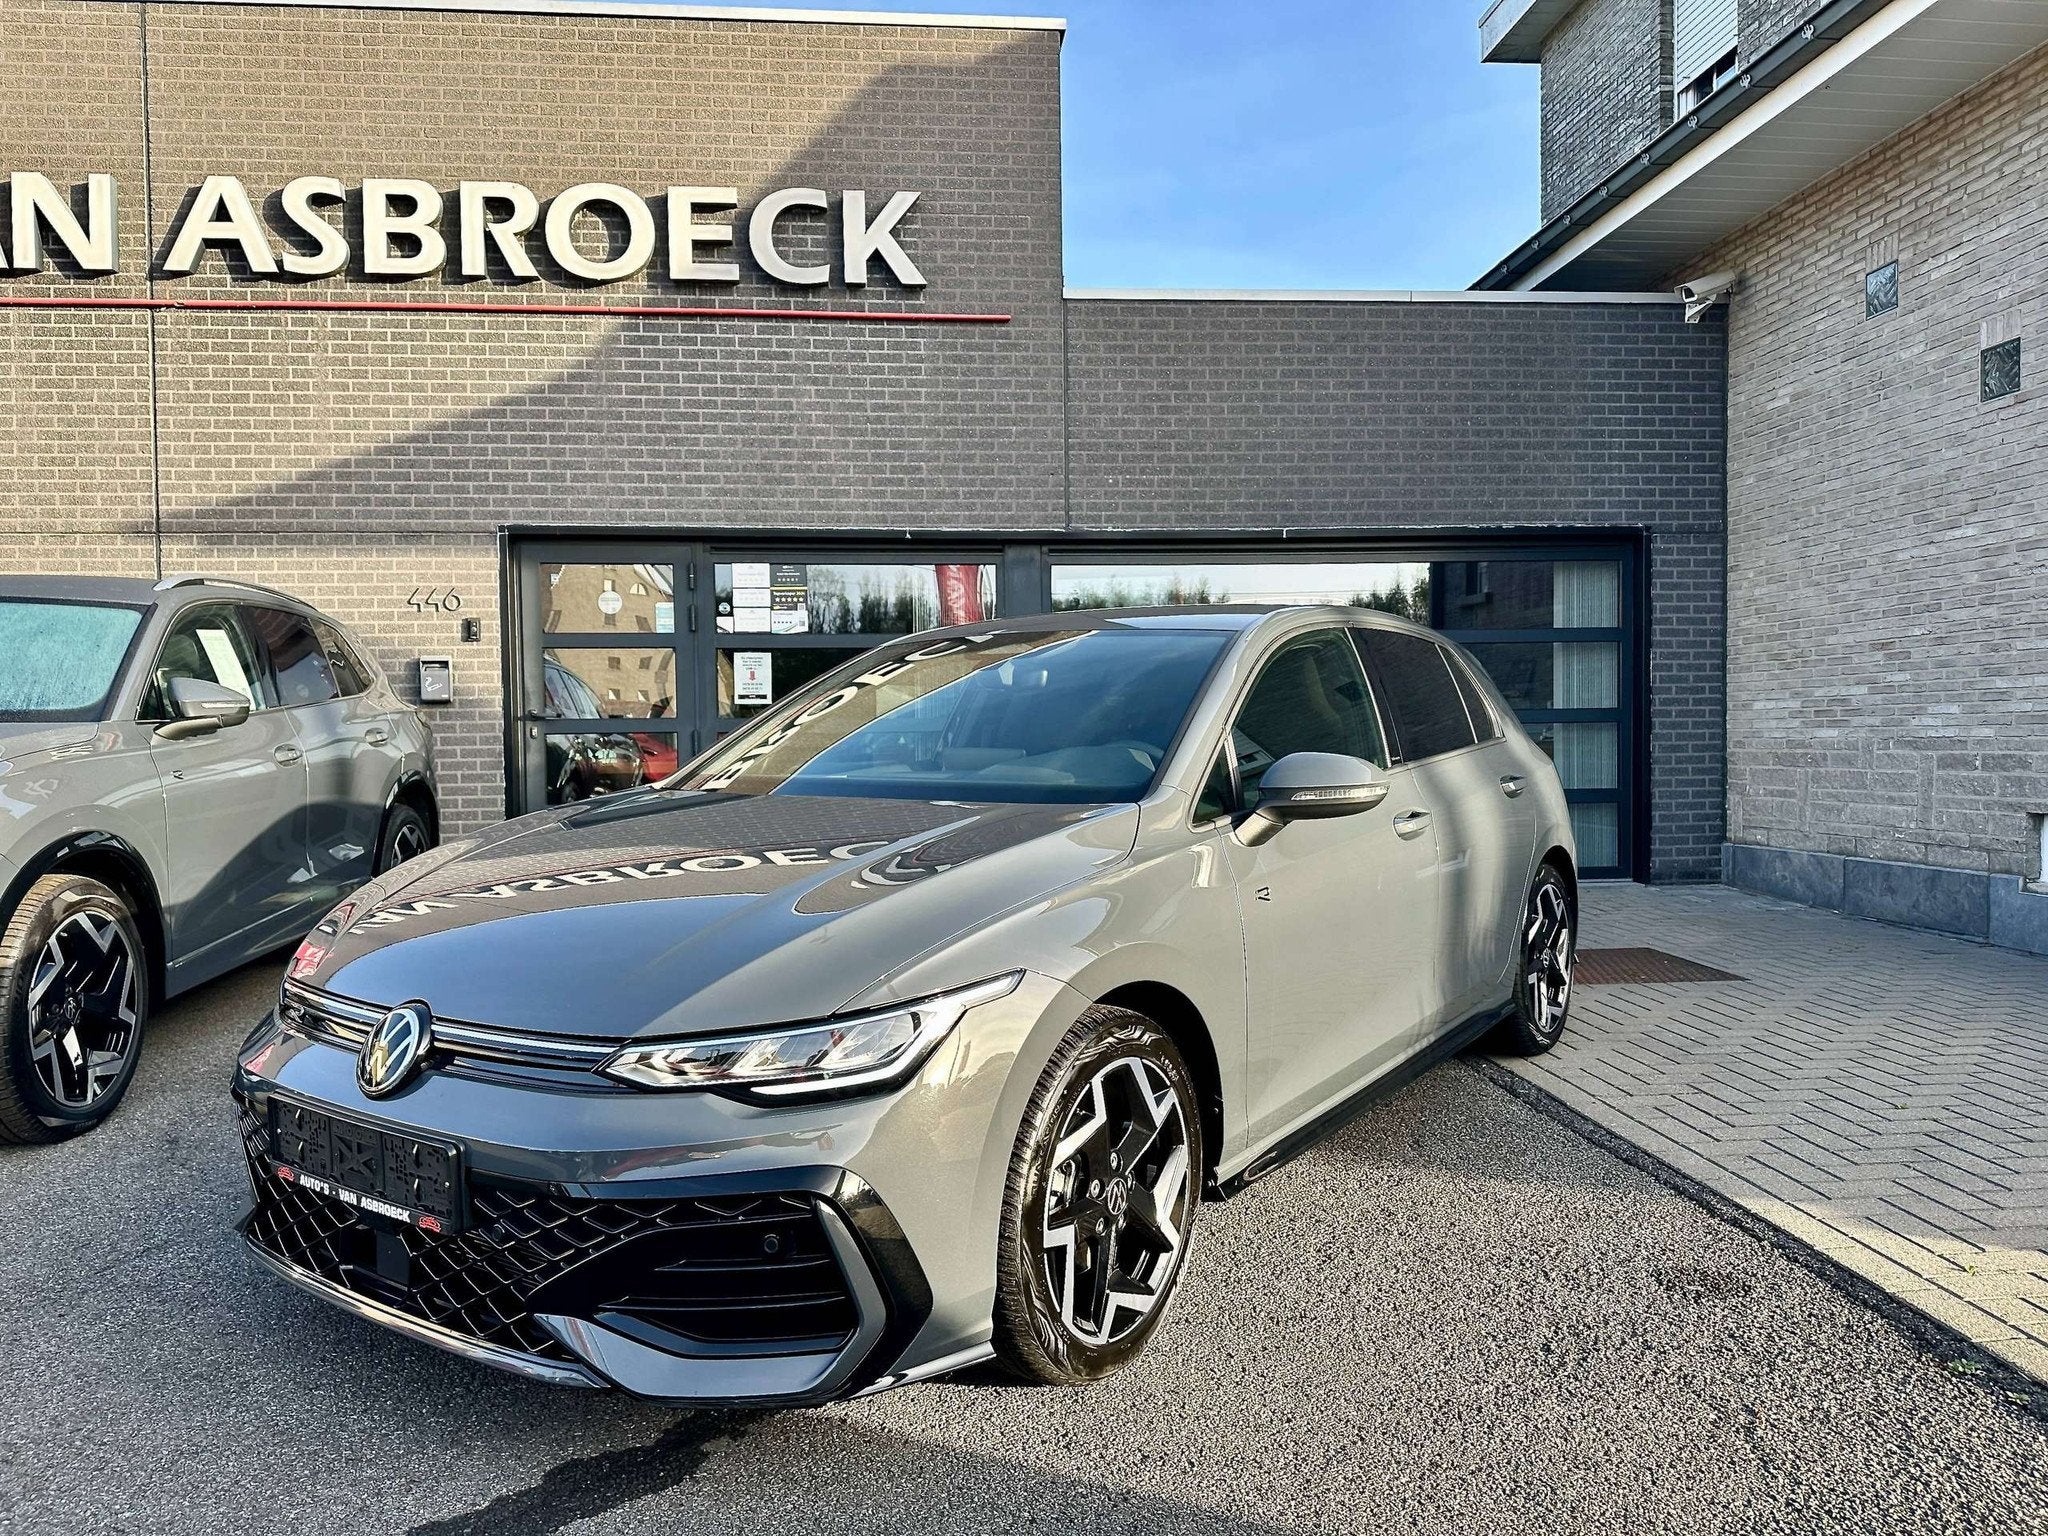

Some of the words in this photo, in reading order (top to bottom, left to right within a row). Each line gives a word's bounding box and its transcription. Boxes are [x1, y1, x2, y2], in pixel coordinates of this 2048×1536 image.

[0, 172, 118, 274] N
[162, 174, 928, 288] ASBROECK
[407, 587, 461, 612] 446
[299, 1174, 330, 1196] AUTO'S
[338, 1189, 358, 1206] VAN
[360, 1193, 411, 1223] ASBROECK
